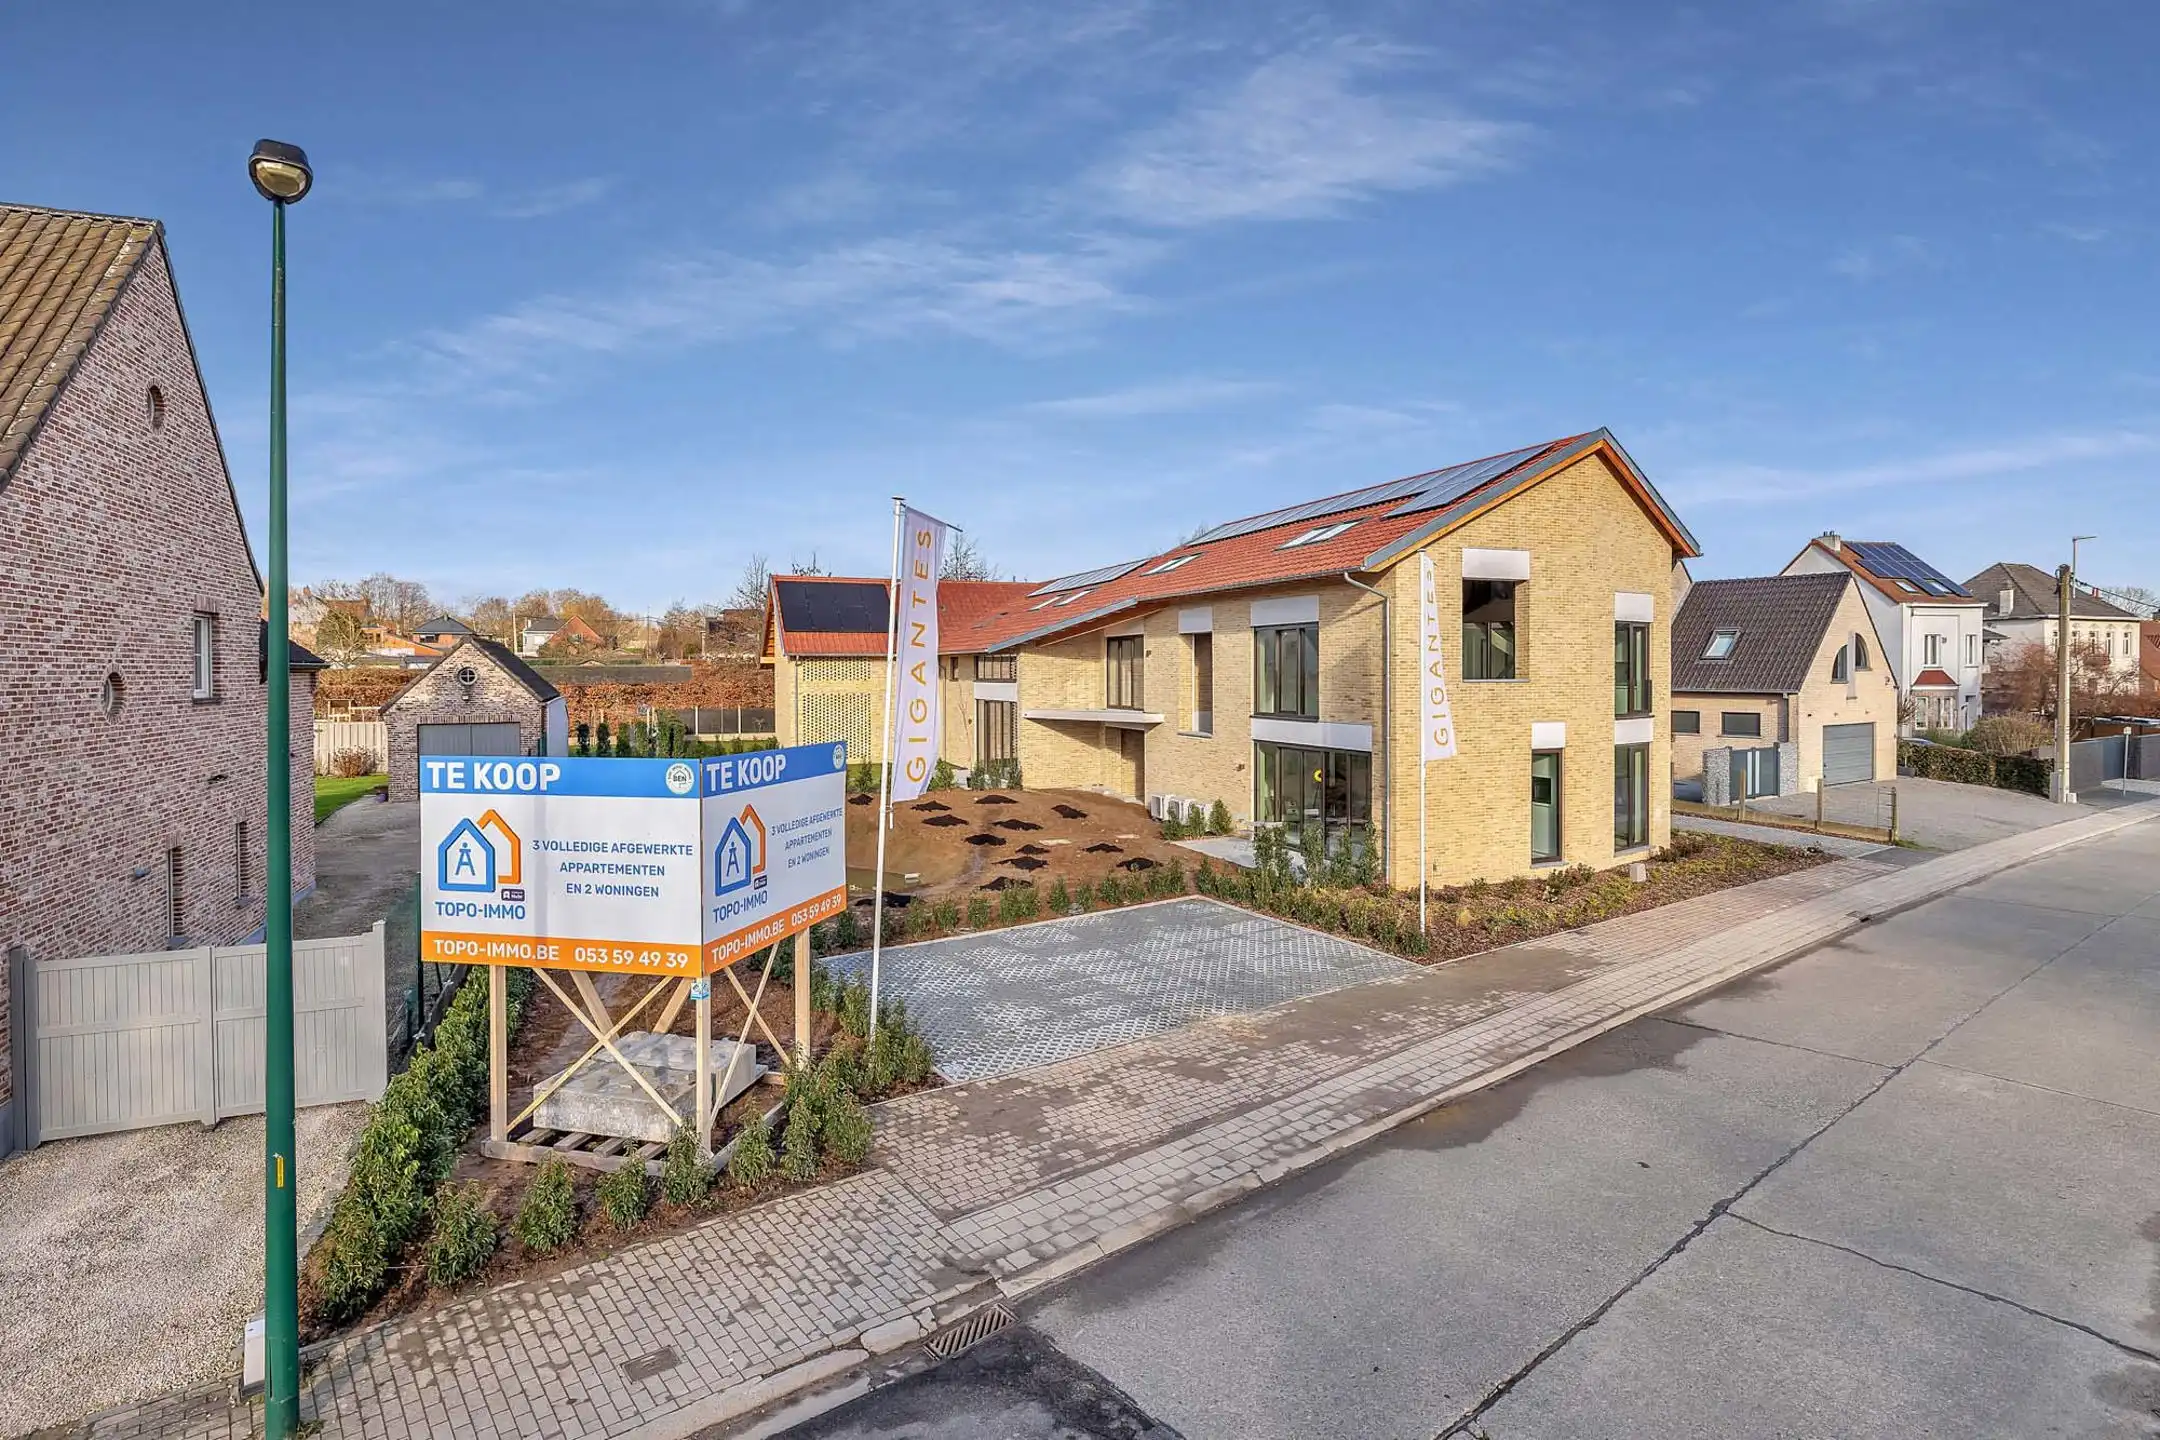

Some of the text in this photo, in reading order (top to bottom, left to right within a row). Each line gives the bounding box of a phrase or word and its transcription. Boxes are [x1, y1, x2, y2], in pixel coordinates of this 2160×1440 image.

[906, 529, 932, 783] GIGANTES
[426, 761, 561, 791] TE KOOP
[706, 761, 733, 791] TE
[738, 754, 787, 786] KOOP
[771, 808, 843, 836] 3 VOLLEDIGE AFGEWERKTE
[532, 840, 693, 856] 3 VOLLEDIGE AFGEWERKTE
[785, 828, 832, 850] APPARTEMENTEN
[560, 862, 665, 876] APPARTEMENTEN
[788, 847, 829, 869] EN 2 WONINGEN
[566, 883, 659, 897] EN 2 WONINGEN
[434, 901, 526, 920] TOPO-IMMO
[712, 890, 768, 924] TOPO-IMMO
[712, 893, 842, 964] TOPO-IMMO.BE 053 59 49 39
[433, 939, 689, 969] TOPO-IMMO.BE 053 59 49 39
